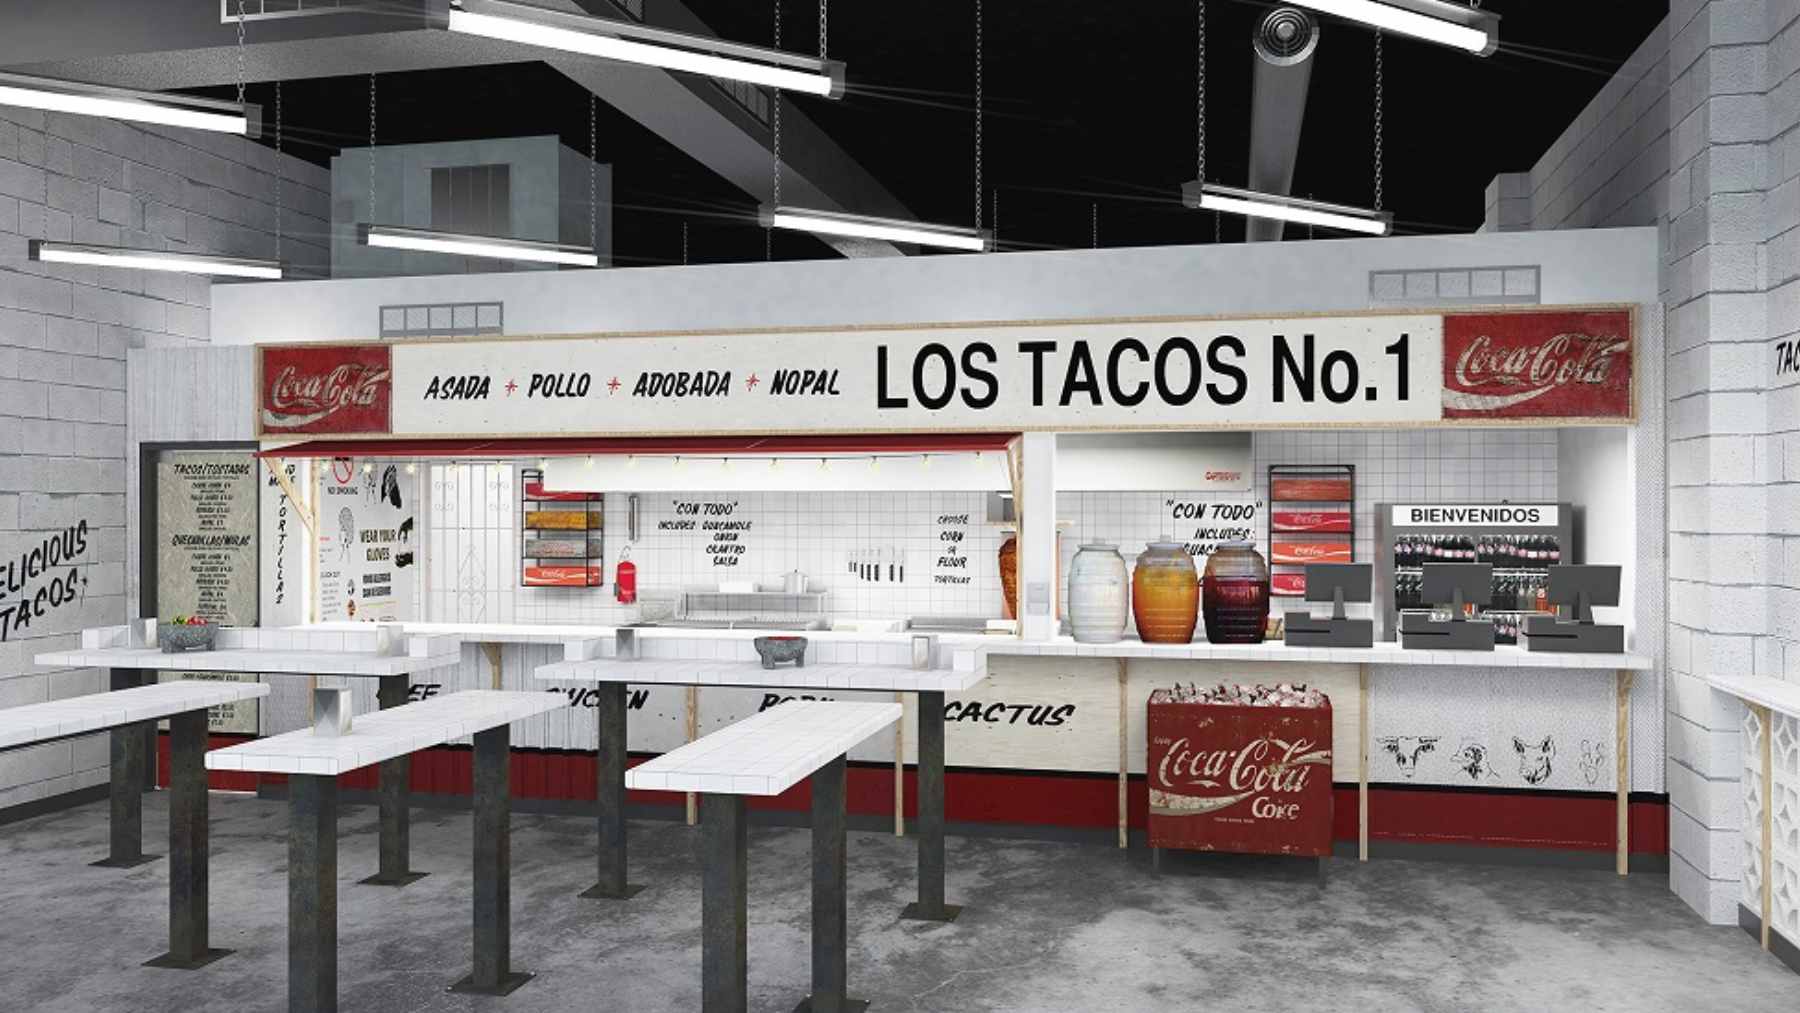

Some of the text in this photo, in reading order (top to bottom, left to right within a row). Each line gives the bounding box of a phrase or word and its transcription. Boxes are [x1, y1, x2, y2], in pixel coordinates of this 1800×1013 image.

[876, 332, 1410, 410] LOS TACOS No.1
[424, 369, 841, 400] ASADA POLLO ADOBADA NOPAL
[1410, 508, 1541, 523] BIENVENIDOS
[943, 700, 1076, 726] CACTUS
[1251, 796, 1300, 820] Coke
